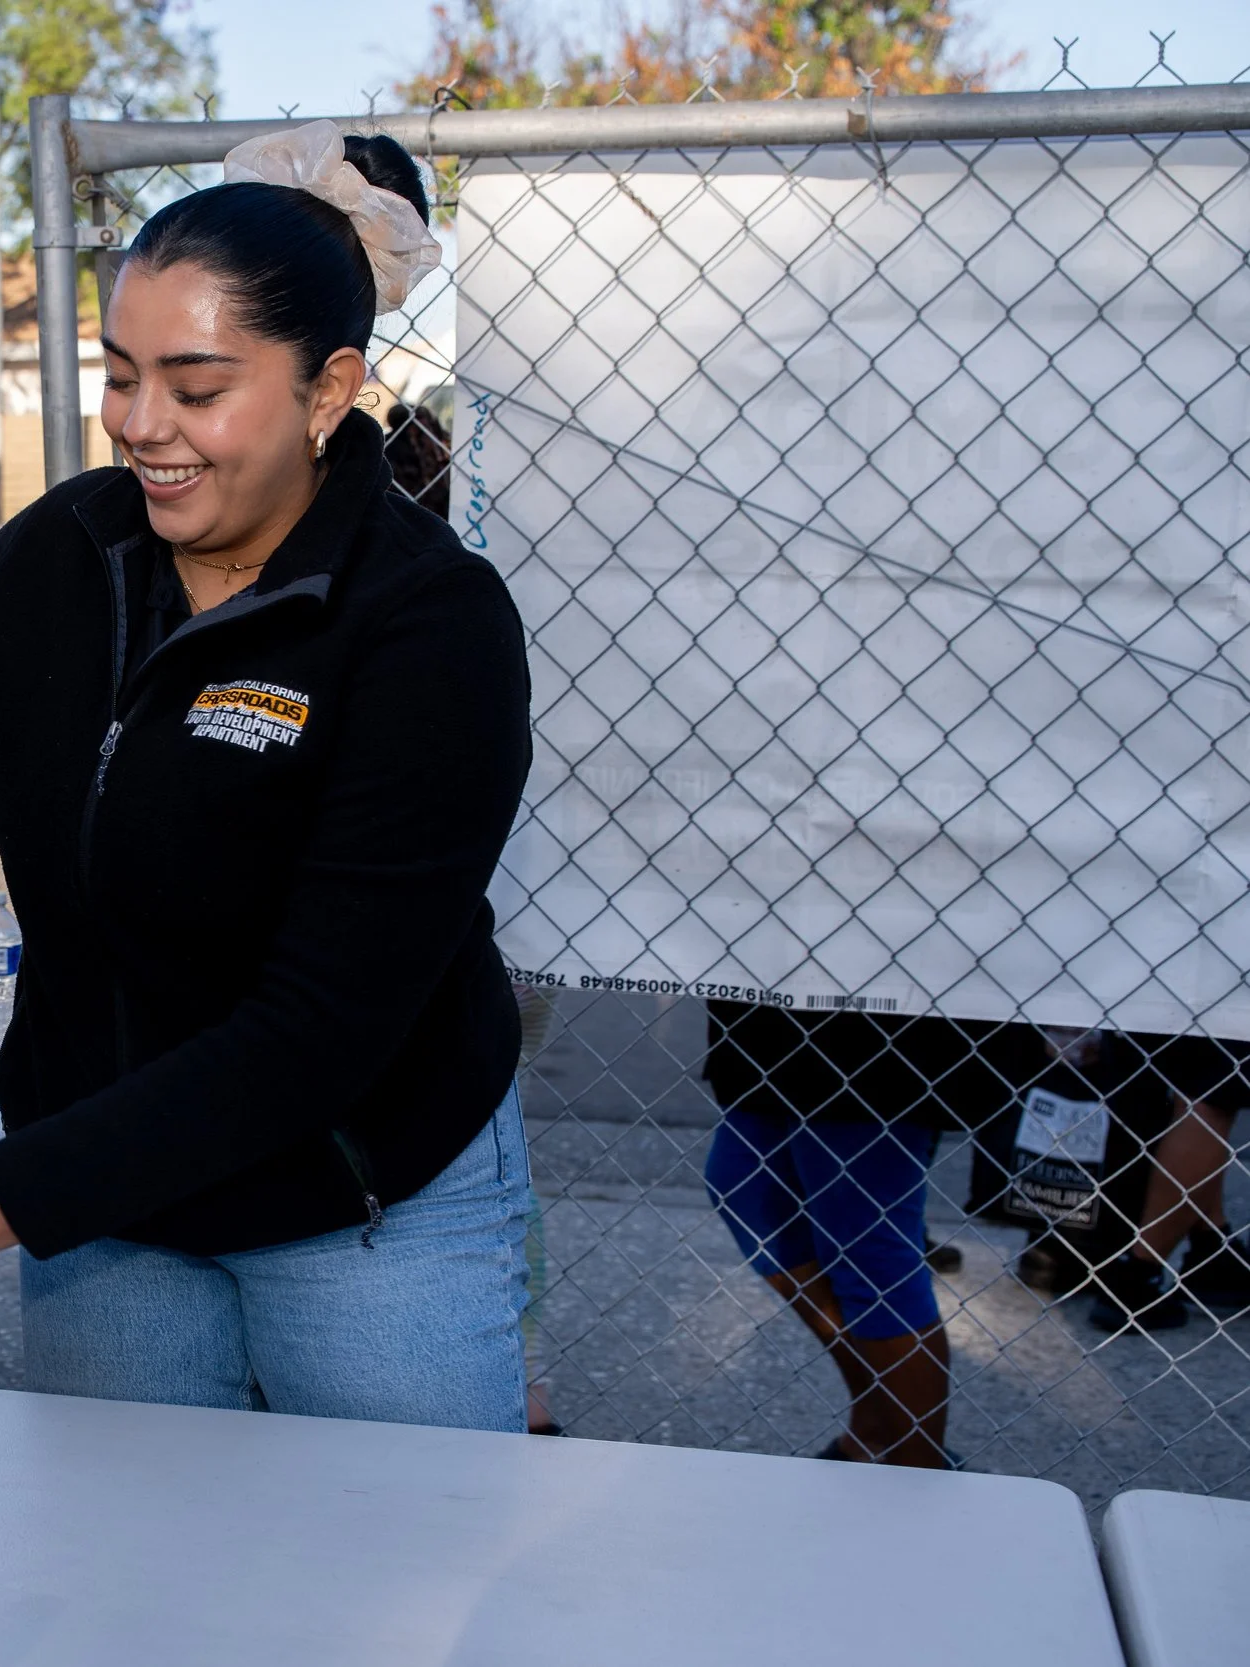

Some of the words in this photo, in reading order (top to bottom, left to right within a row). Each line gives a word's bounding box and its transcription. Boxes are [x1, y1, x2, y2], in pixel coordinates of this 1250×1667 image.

[197, 690, 303, 721] CROSSROADS
[242, 680, 310, 706] CALIFORNIA
[191, 724, 270, 753] DEPARTMENT
[210, 711, 301, 747] DEVELOPMENT
